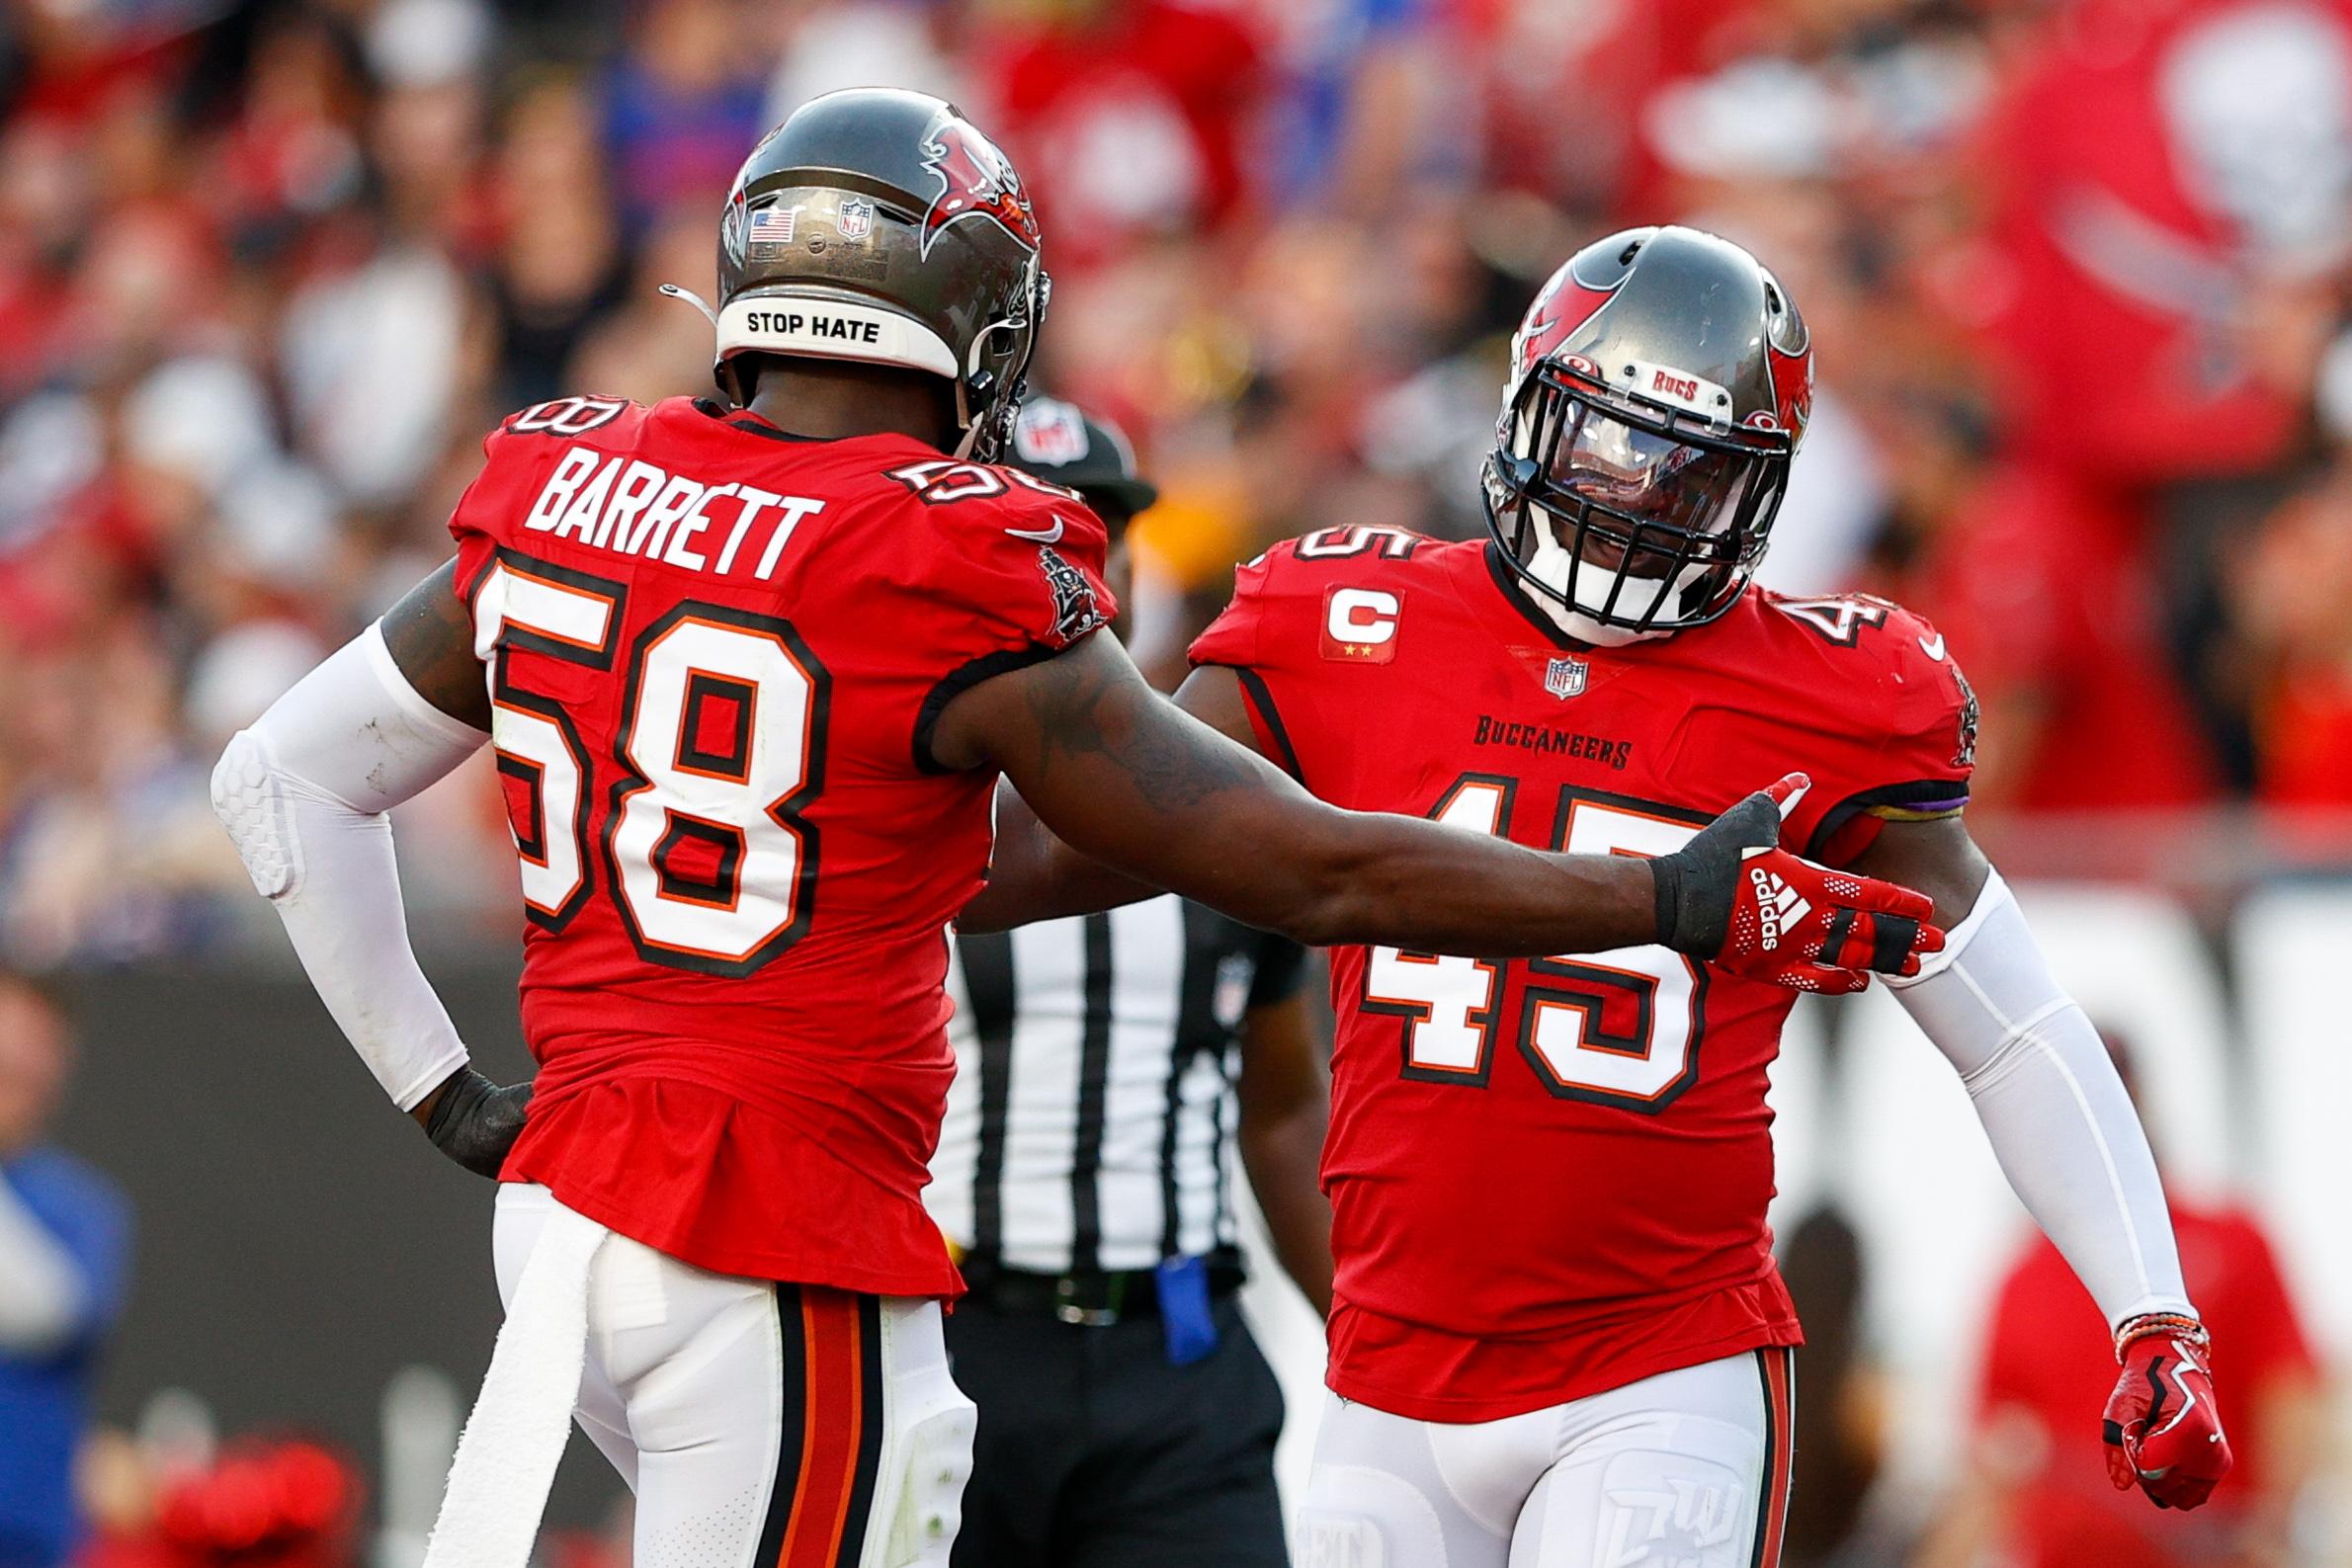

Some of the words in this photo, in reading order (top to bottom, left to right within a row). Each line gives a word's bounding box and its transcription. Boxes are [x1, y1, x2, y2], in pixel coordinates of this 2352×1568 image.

[747, 312, 803, 334] STOP
[811, 316, 881, 344] HATE
[524, 447, 826, 581] BARRETT
[1328, 588, 1399, 645] C
[1552, 673, 1581, 691] NFL
[467, 546, 832, 979] 58
[1473, 714, 1633, 772] BUCCANEERS
[1360, 772, 1712, 1114] 45
[1750, 867, 1780, 950] adidas
